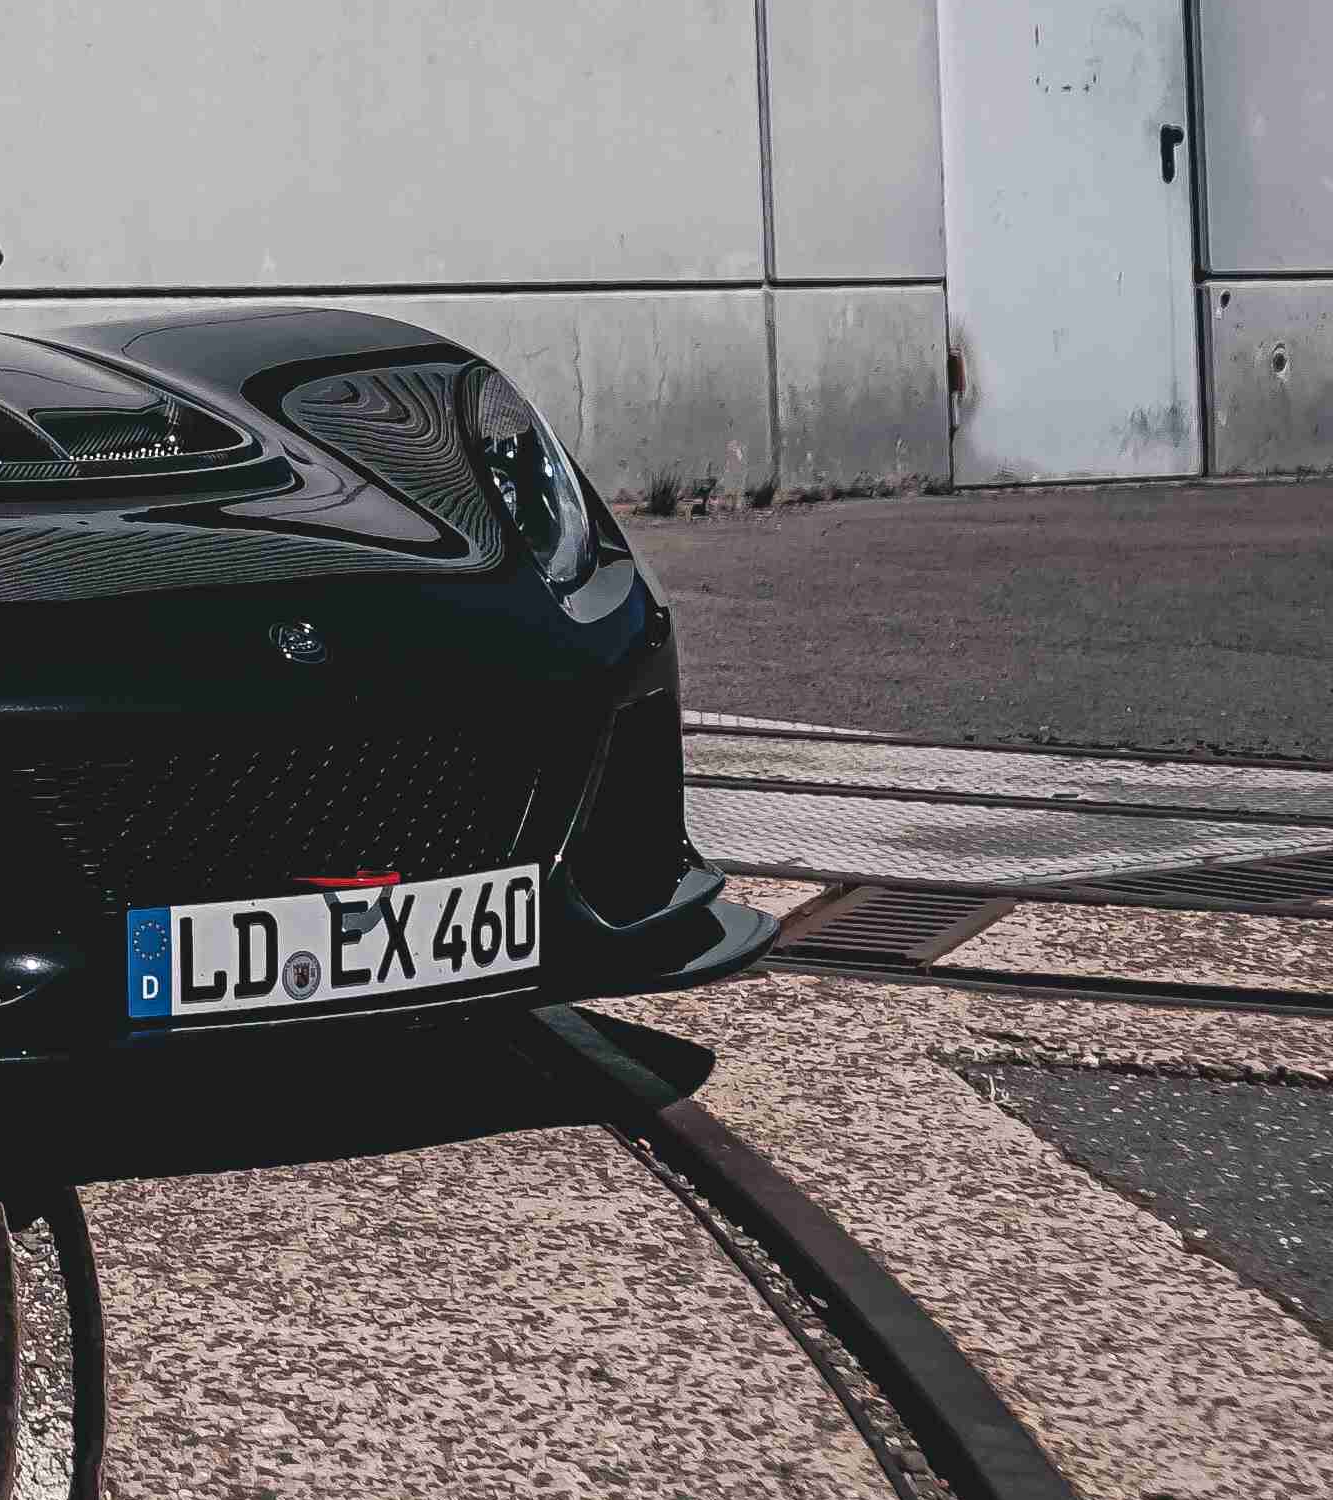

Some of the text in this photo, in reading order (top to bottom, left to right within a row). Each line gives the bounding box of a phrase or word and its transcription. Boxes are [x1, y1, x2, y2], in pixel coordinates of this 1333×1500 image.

[179, 876, 534, 1005] LD EX 460
[142, 975, 159, 1000] D
